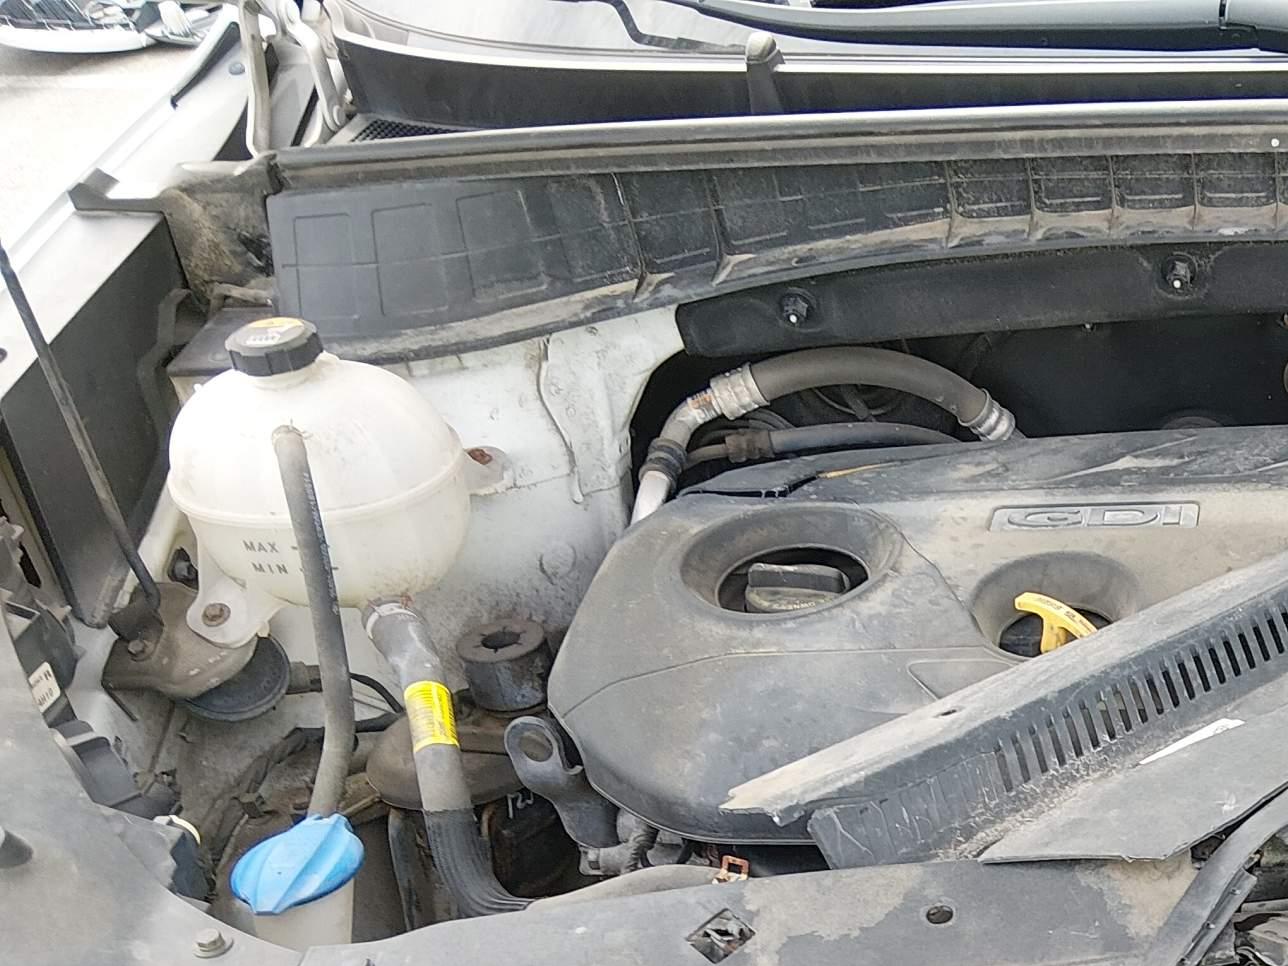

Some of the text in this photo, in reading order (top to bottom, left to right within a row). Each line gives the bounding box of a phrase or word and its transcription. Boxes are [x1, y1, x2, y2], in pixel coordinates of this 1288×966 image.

[1007, 505, 1183, 527] GDI
[242, 540, 279, 553] MAX
[252, 562, 288, 574] MIN
